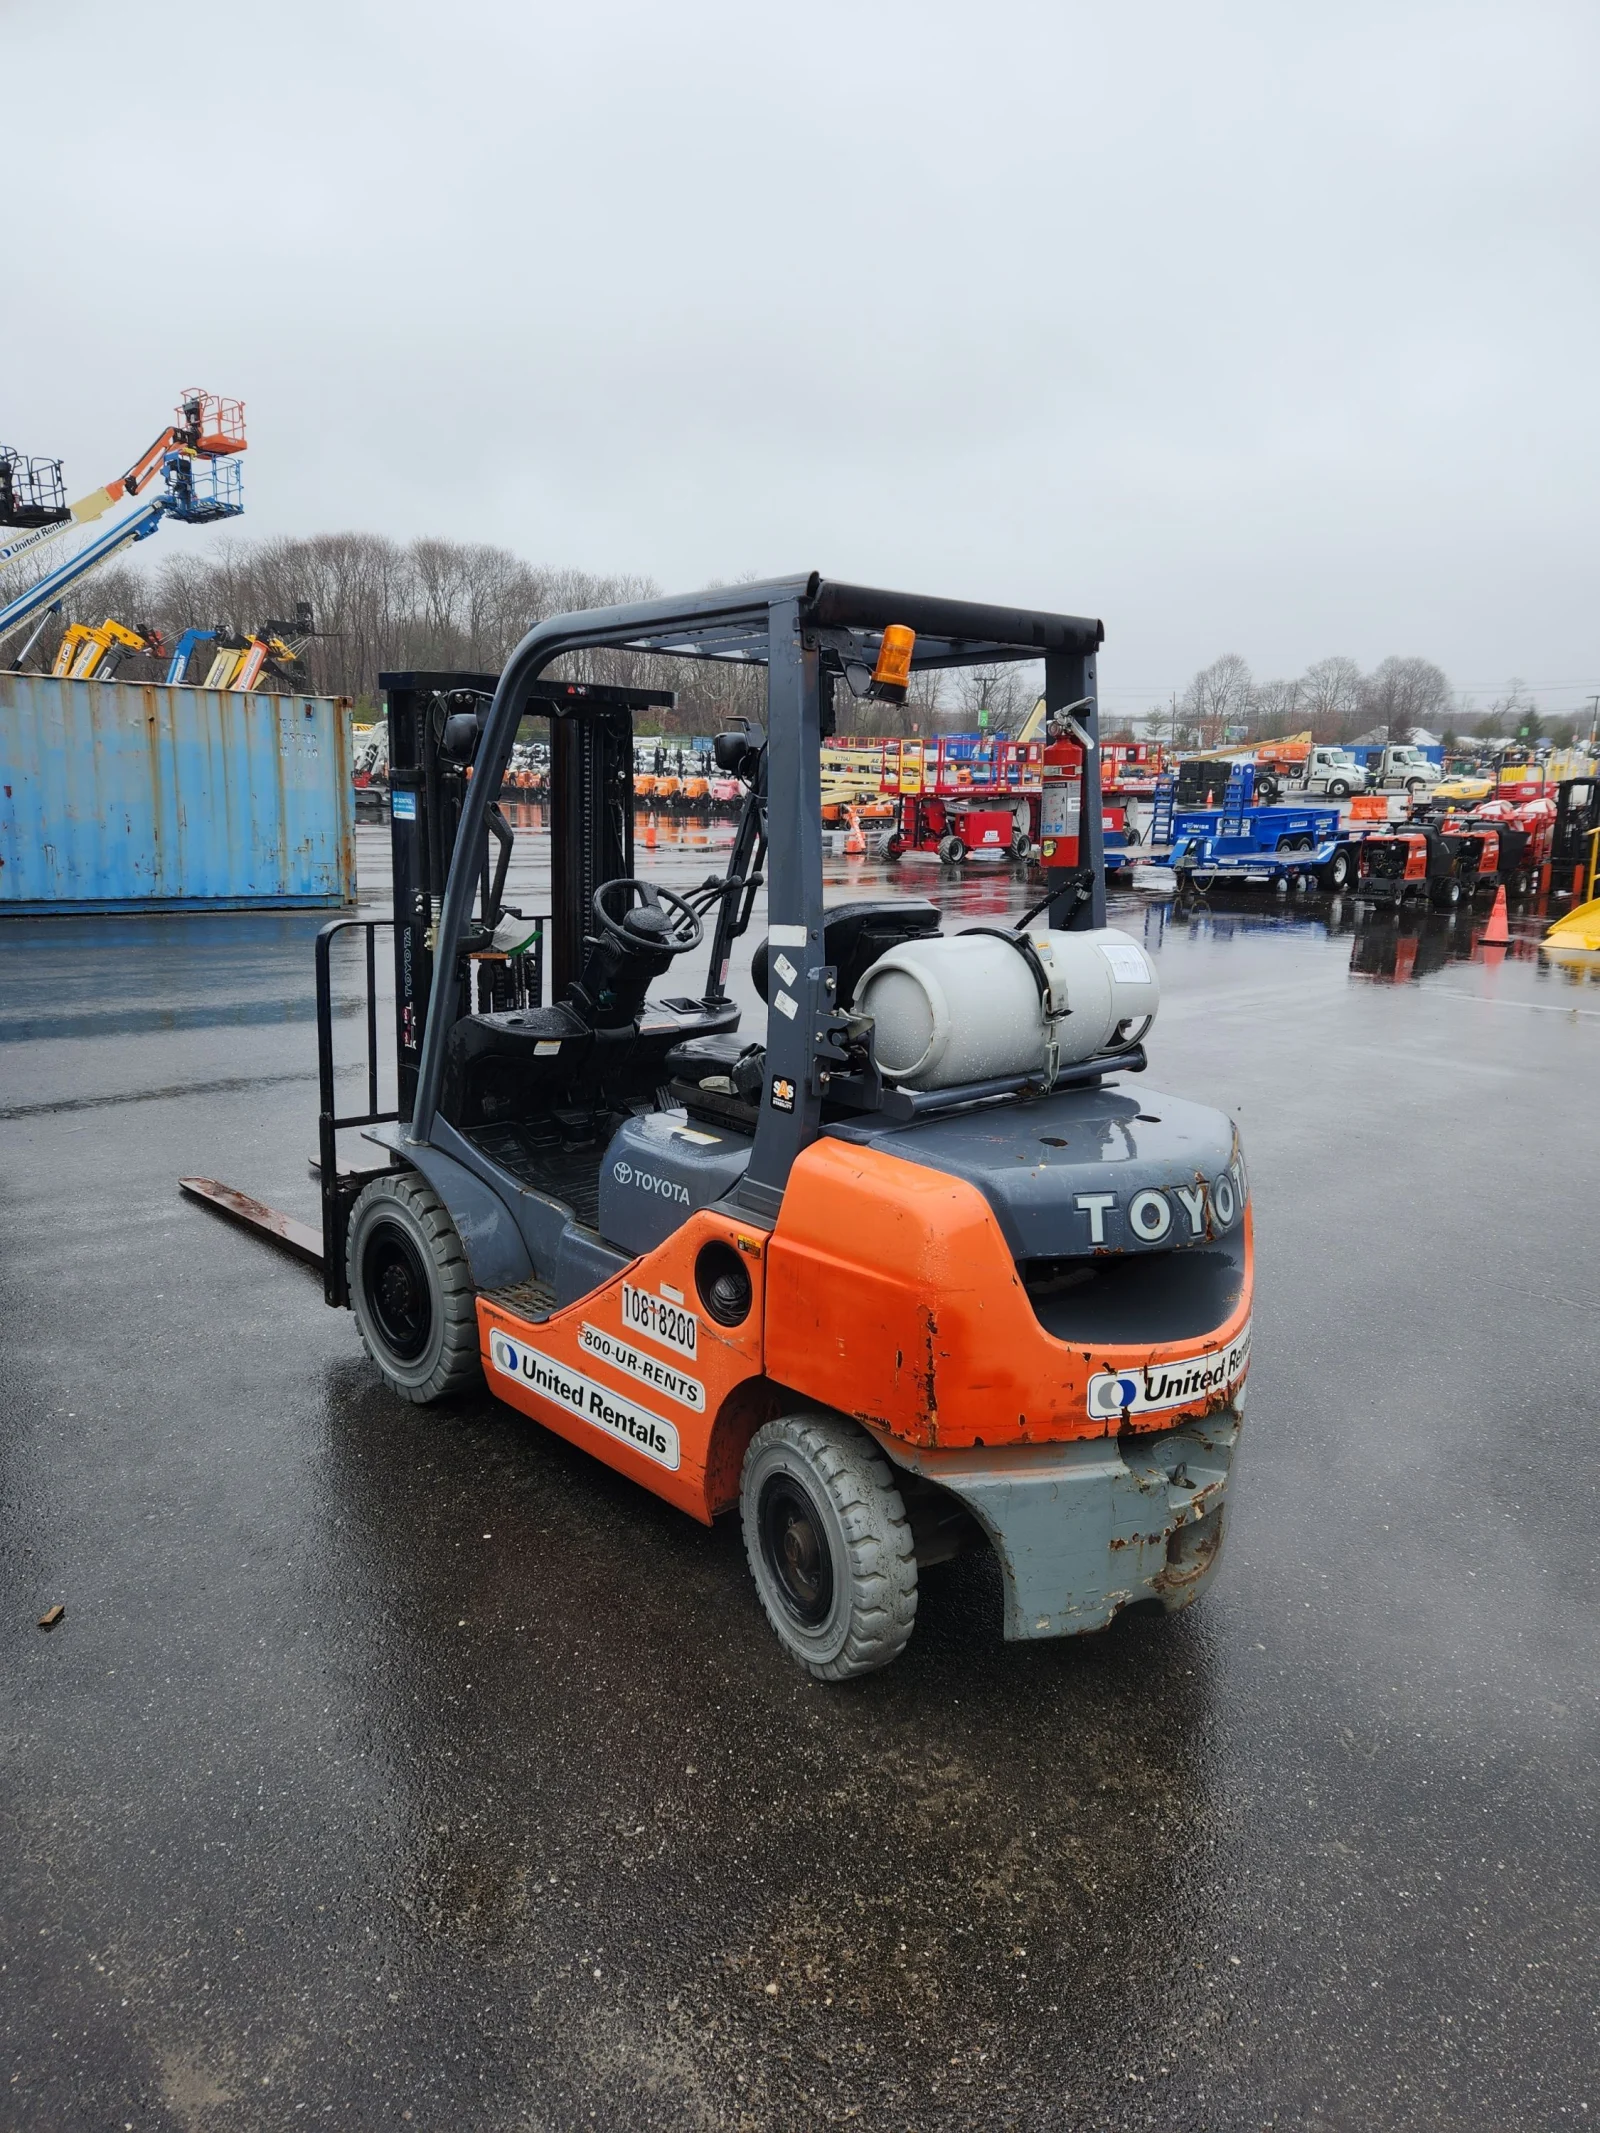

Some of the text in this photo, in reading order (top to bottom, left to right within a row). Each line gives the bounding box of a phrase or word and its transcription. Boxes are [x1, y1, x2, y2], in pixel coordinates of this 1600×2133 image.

[11, 532, 41, 553] United
[60, 643, 71, 663] JCB
[404, 927, 412, 996] TOYOTA
[773, 1080, 794, 1099] SAS
[634, 1170, 690, 1205] TOYOTA
[1144, 1356, 1226, 1402] United
[522, 1355, 667, 1454] United Rentals
